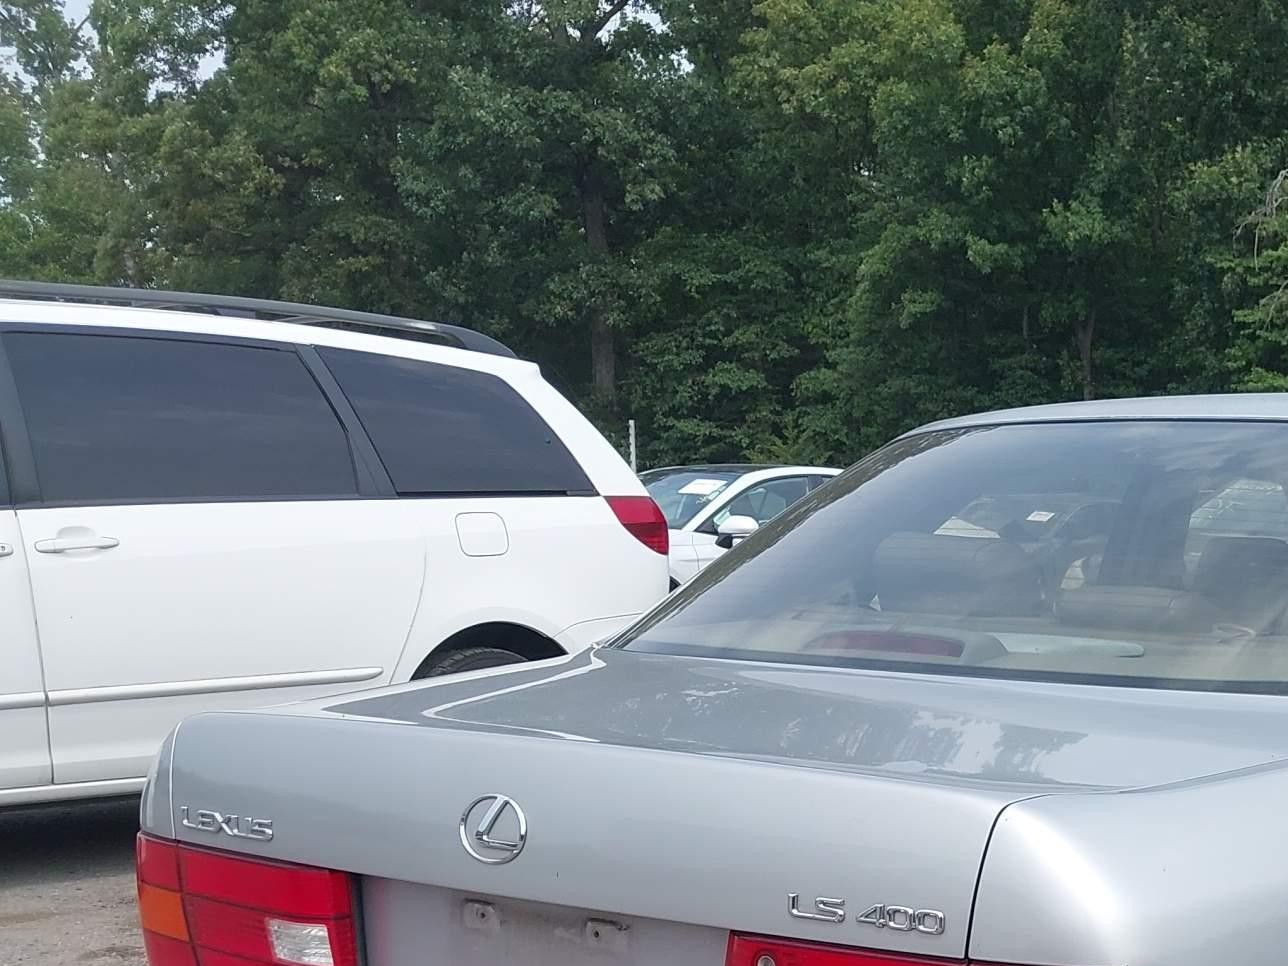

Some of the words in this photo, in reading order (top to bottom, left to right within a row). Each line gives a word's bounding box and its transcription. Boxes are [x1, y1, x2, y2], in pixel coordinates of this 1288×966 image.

[180, 805, 273, 841] LEXUS
[788, 893, 845, 923] LS
[856, 903, 945, 935] 400
